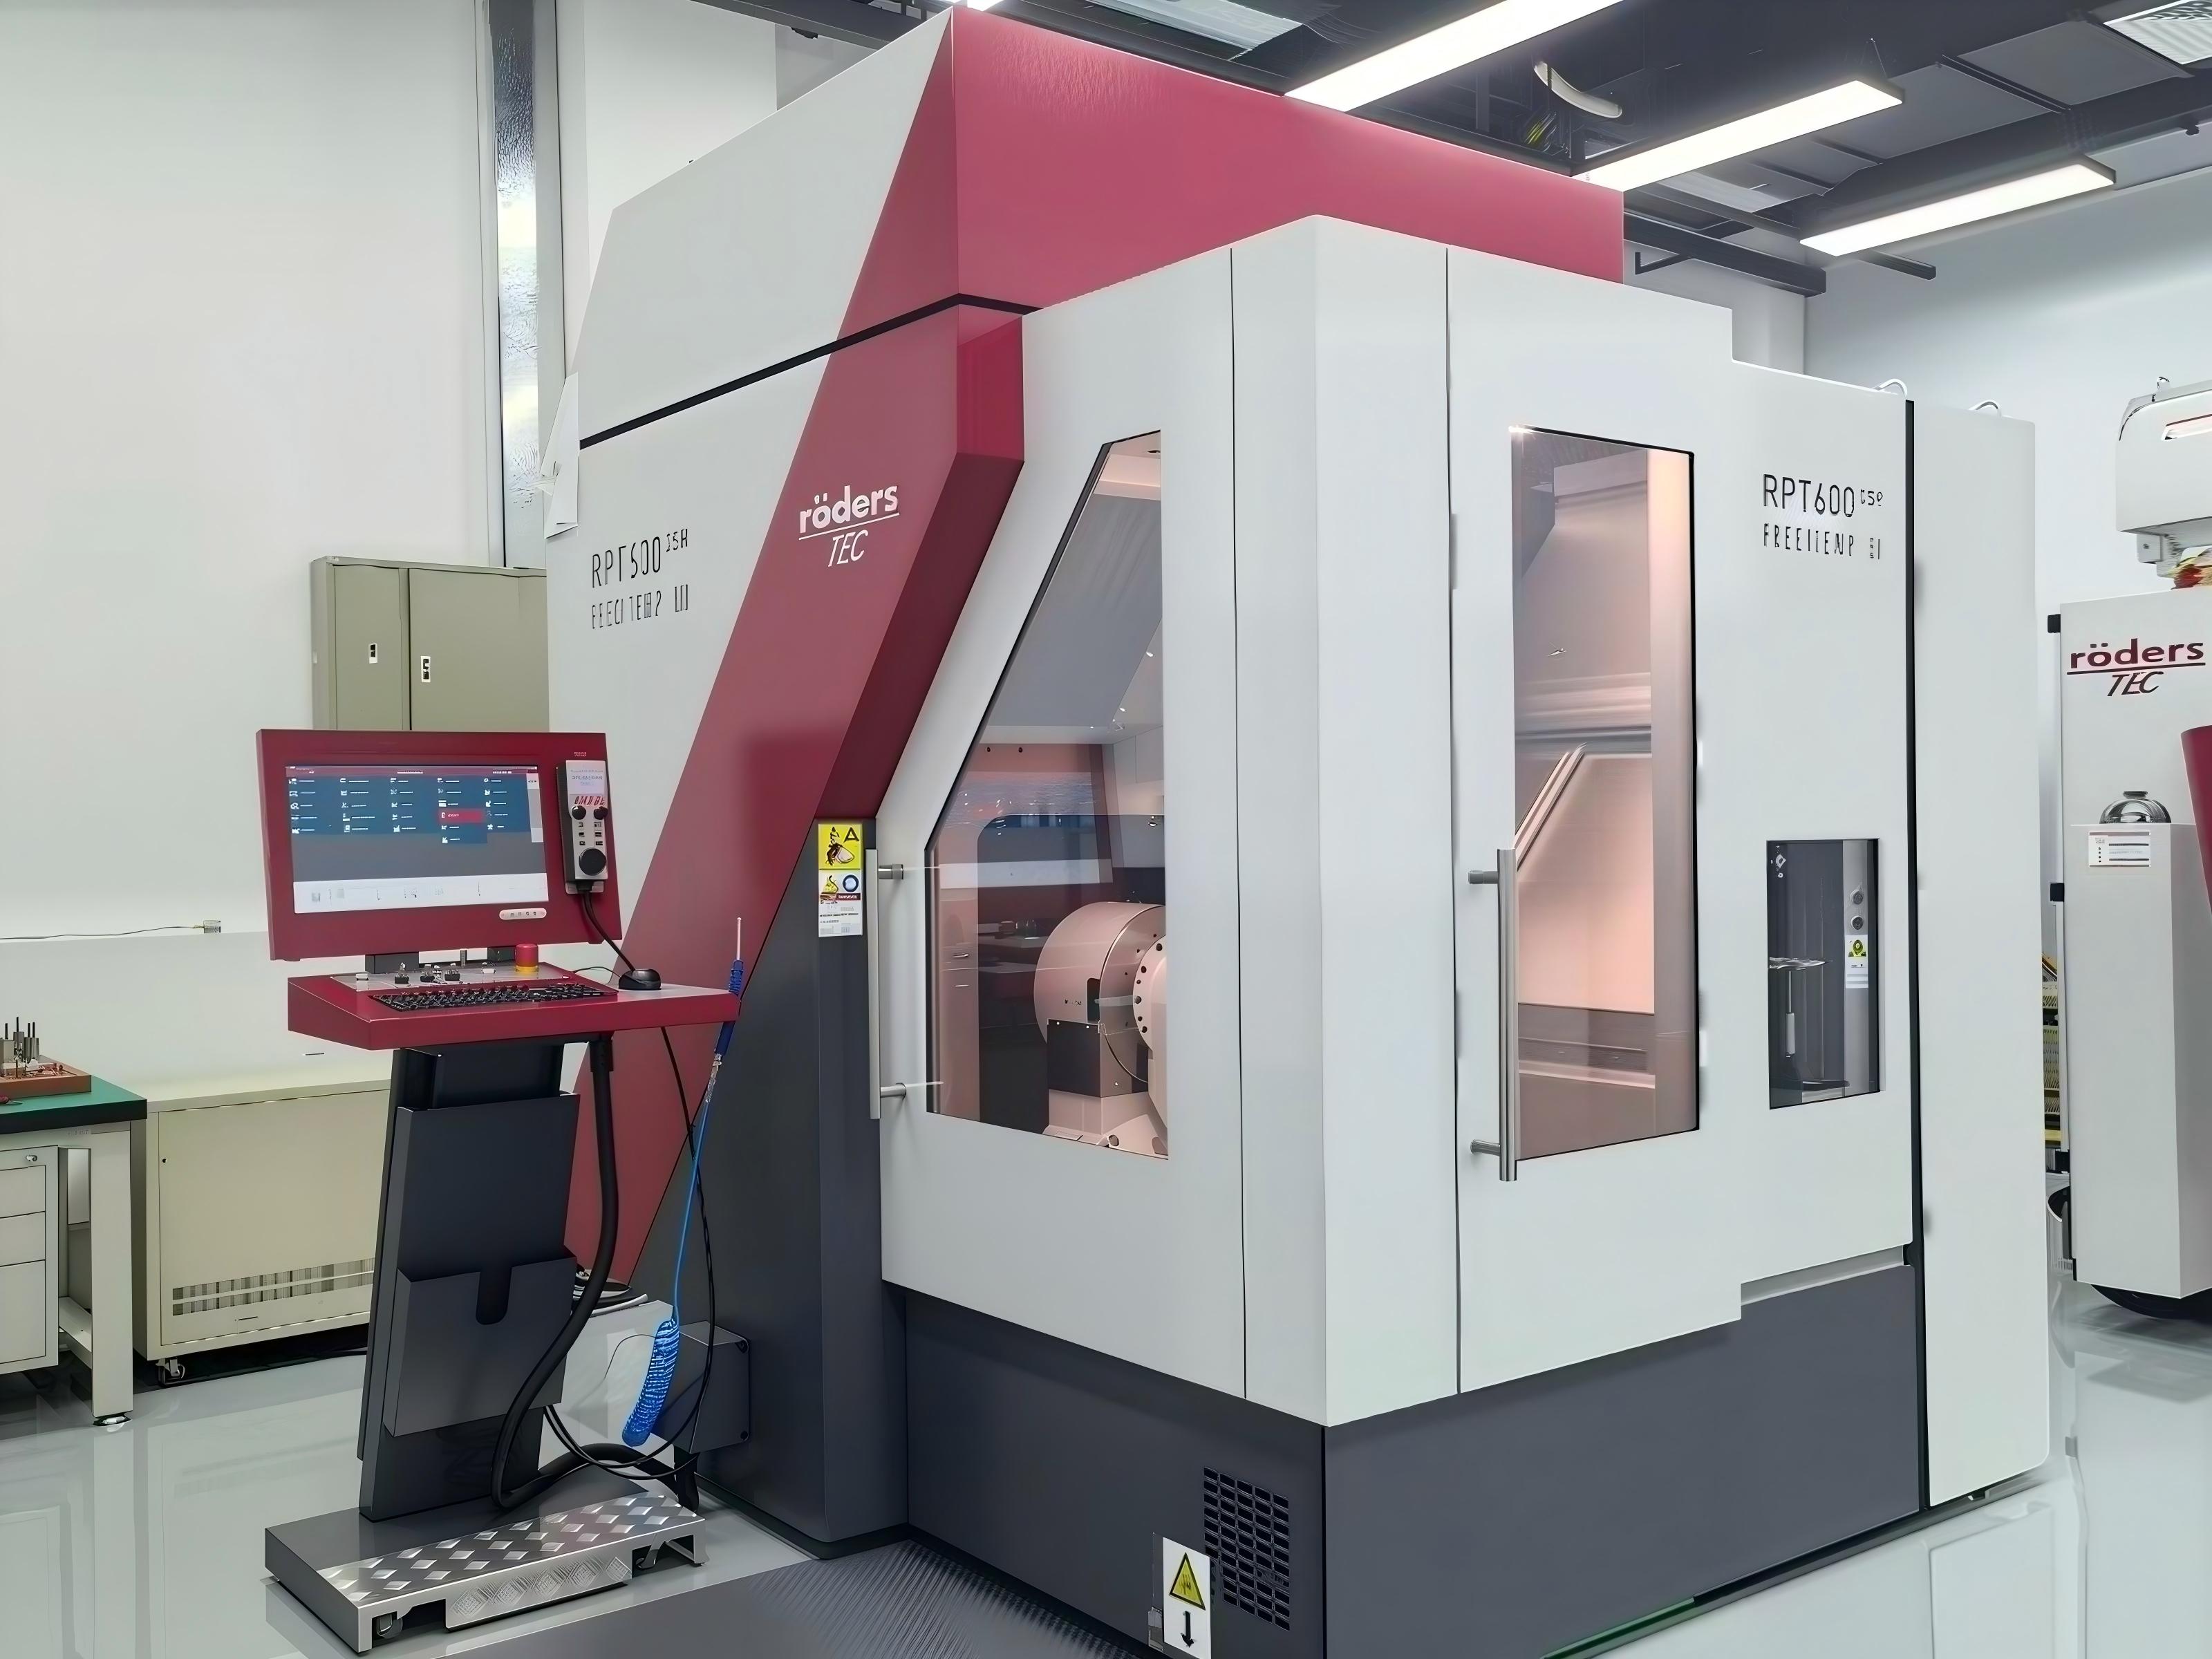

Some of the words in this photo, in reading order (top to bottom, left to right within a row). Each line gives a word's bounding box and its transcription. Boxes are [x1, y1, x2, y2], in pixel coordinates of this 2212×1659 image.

[800, 485, 898, 534] röders
[828, 529, 868, 567] TEC
[2070, 637, 2204, 668] röders
[2107, 671, 2164, 696] TEC
